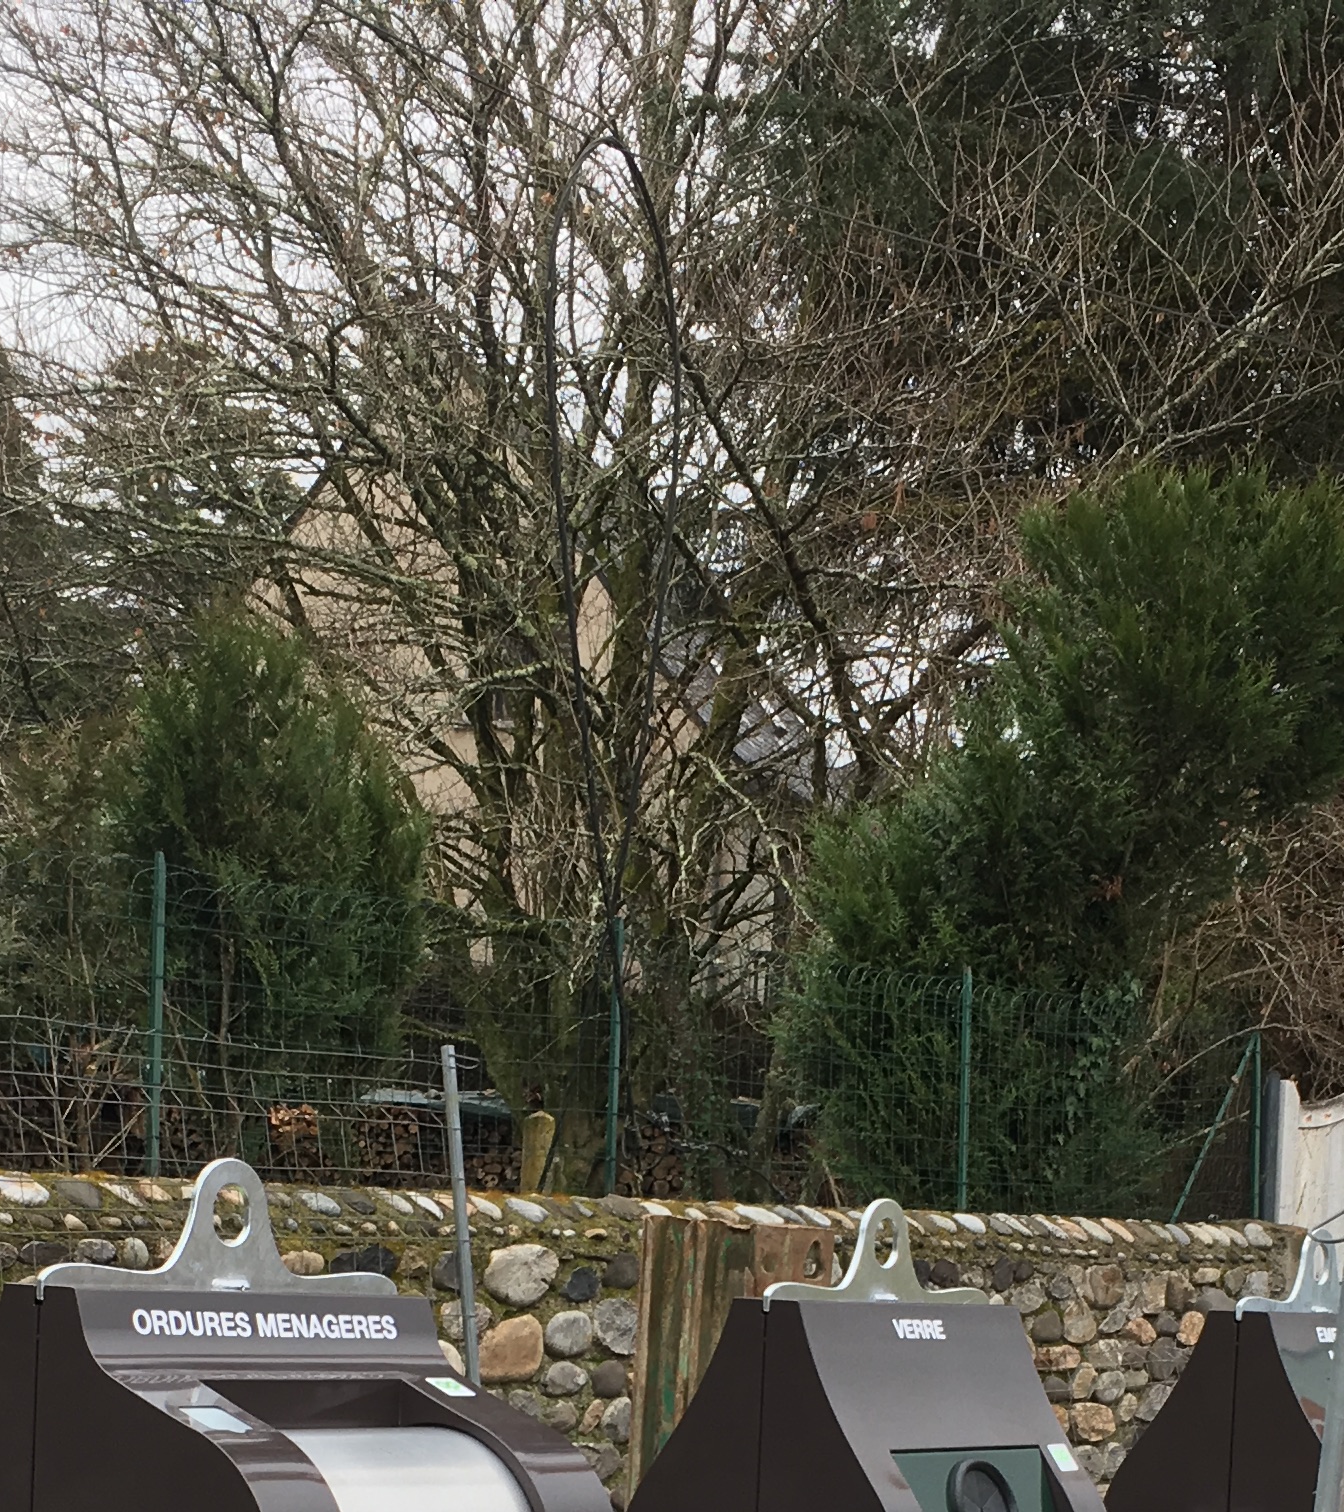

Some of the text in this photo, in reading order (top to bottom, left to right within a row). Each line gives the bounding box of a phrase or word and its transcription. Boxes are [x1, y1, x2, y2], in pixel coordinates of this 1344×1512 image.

[131, 1308, 398, 1340] ORDURES MENAGERES
[891, 1318, 947, 1340] VERRE
